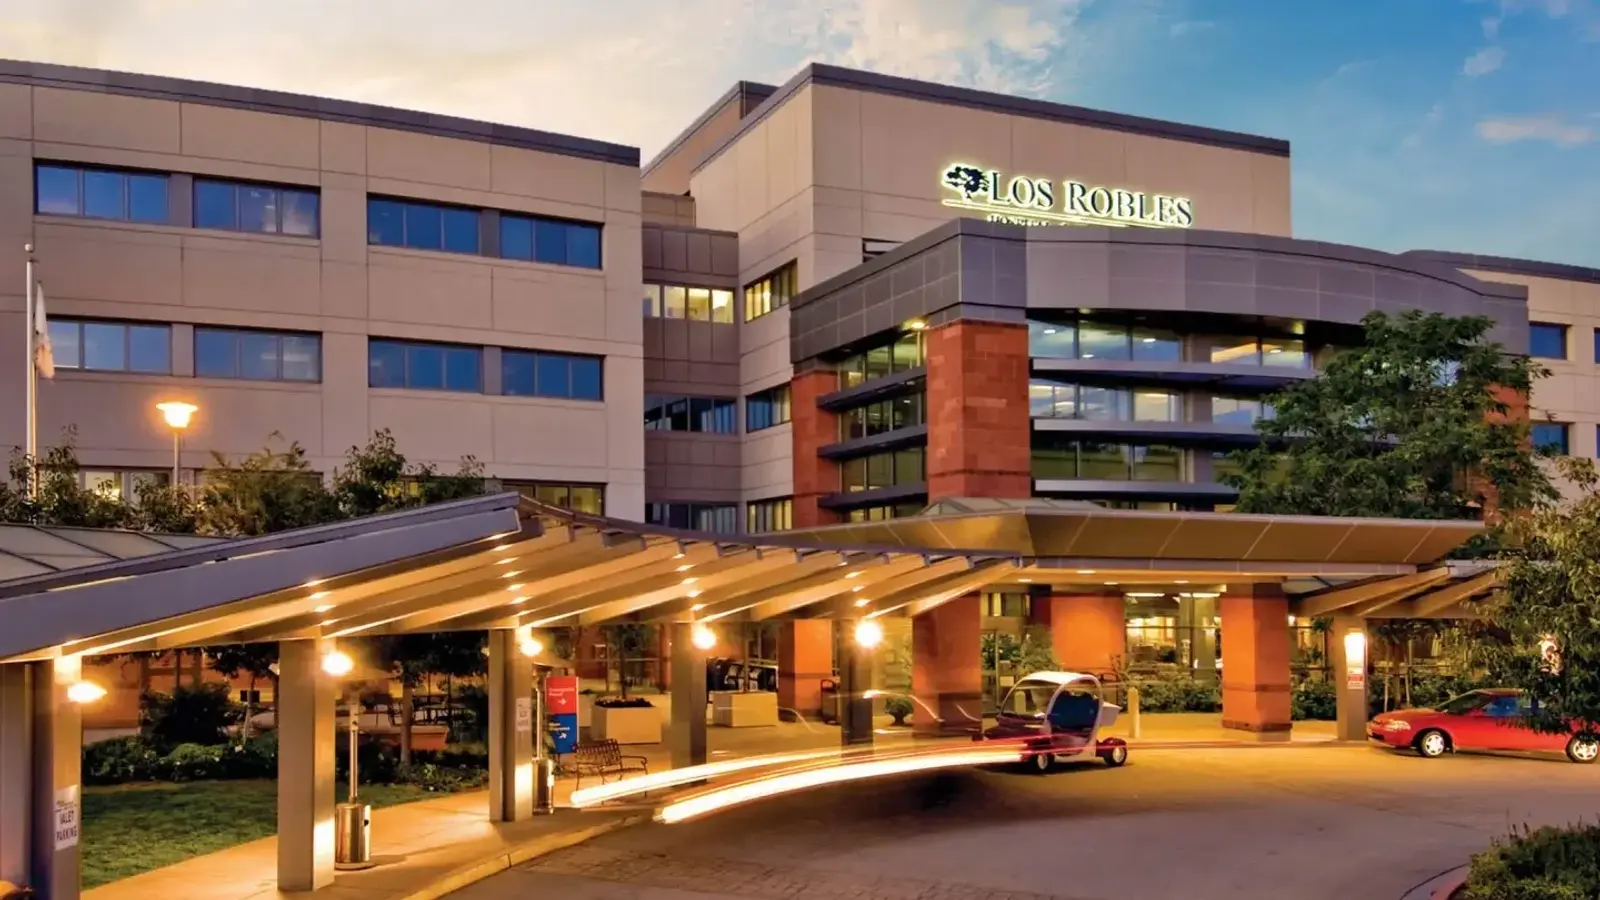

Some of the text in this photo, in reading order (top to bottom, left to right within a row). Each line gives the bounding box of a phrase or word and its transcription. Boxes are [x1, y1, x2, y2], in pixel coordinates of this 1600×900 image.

[988, 170, 1193, 227] LOS ROBLES
[59, 809, 75, 825] VALET
[56, 825, 78, 841] PARKING
